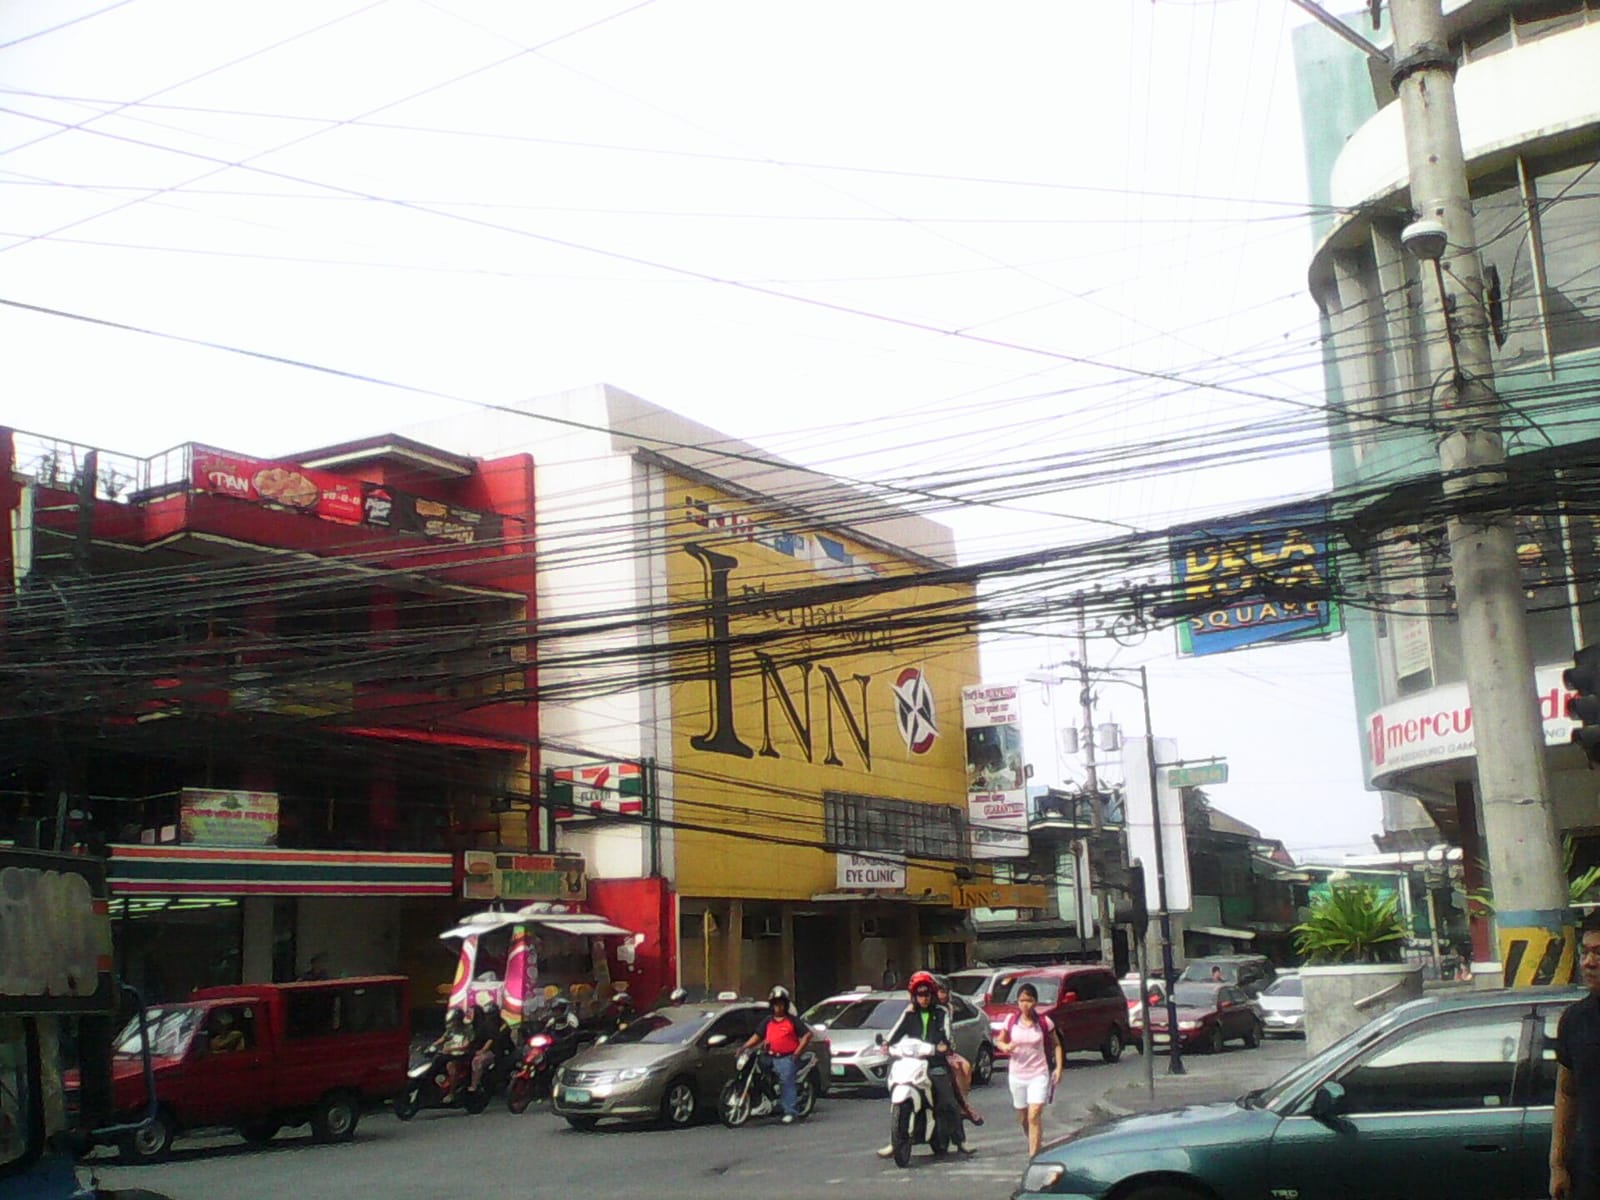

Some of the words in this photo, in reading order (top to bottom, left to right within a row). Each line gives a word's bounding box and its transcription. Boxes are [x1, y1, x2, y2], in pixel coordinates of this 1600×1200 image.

[1387, 706, 1473, 749] mercu
[846, 869, 863, 882] EYE
[865, 868, 897, 882] CLINIC
